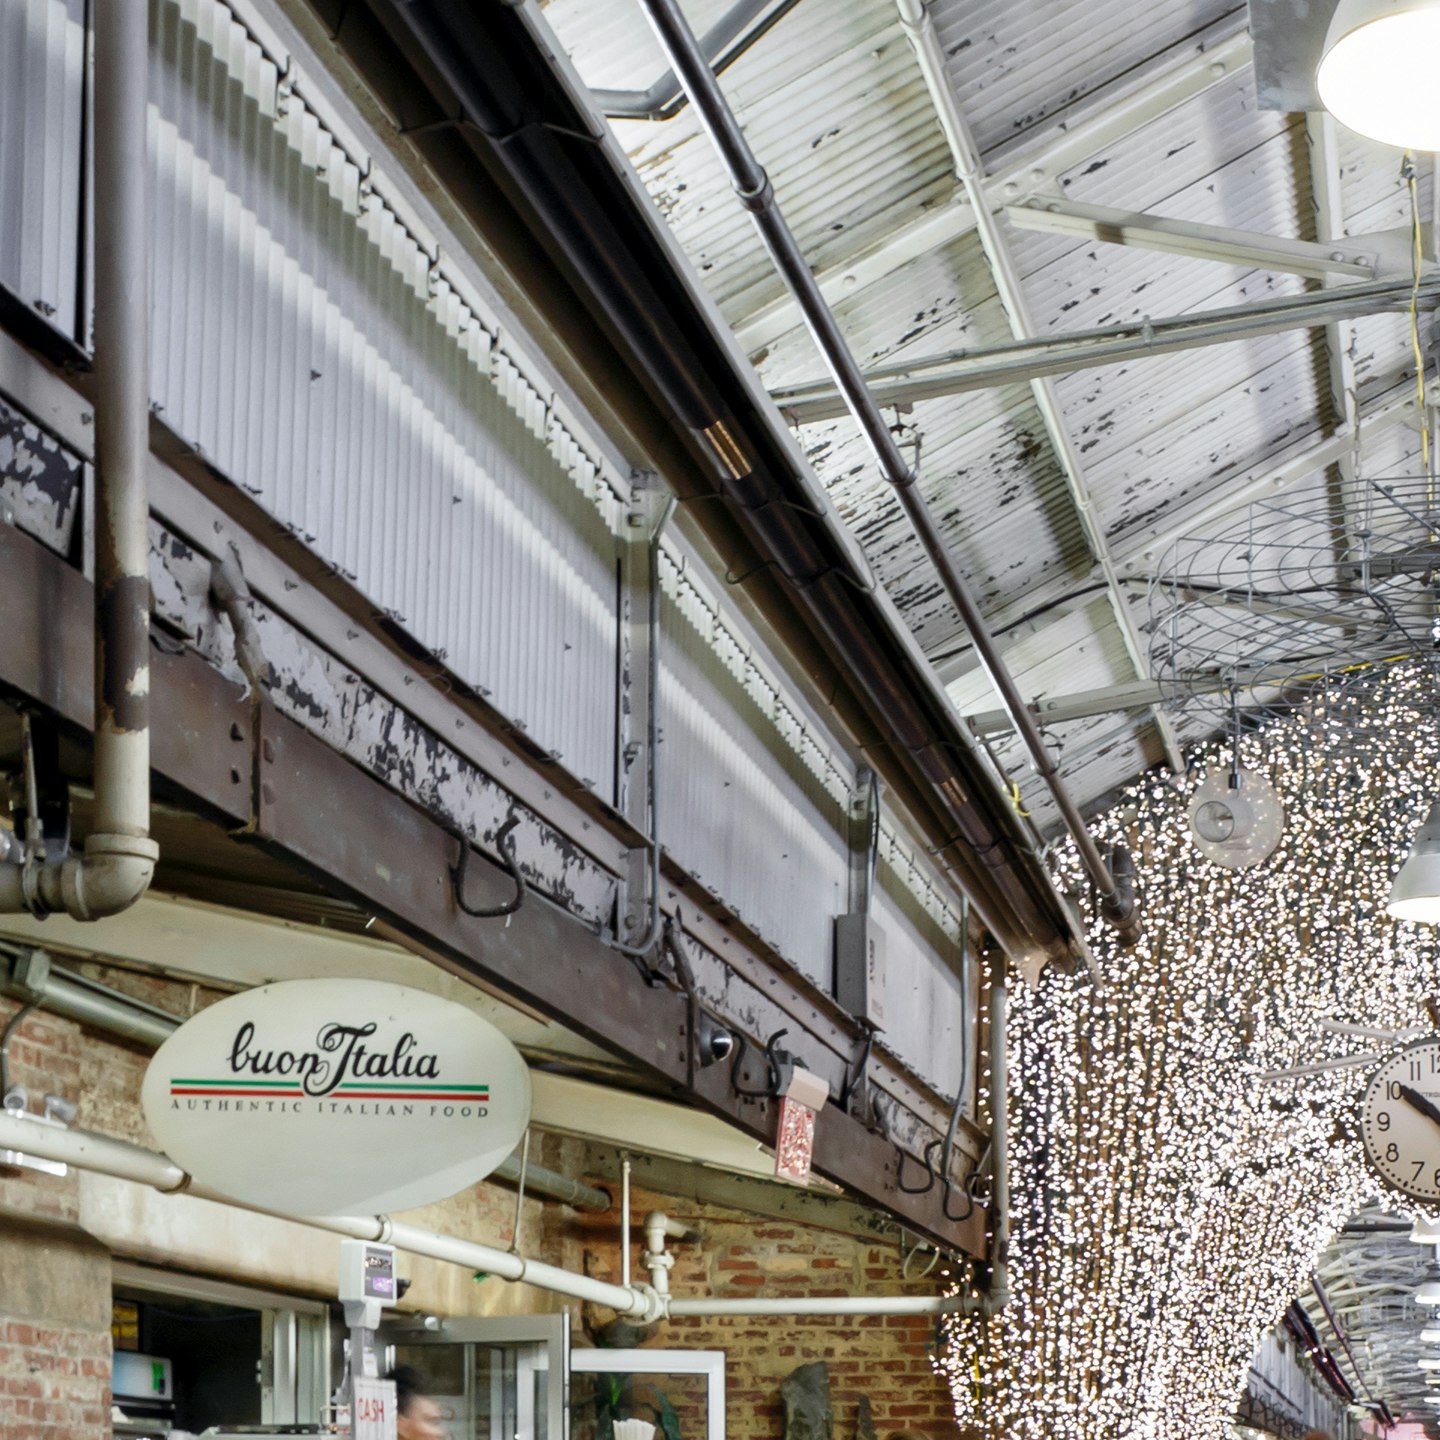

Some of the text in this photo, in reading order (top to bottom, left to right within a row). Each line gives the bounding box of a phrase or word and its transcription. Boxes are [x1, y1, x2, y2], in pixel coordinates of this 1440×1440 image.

[1410, 1061, 1420, 1081] 11
[1386, 1081, 1401, 1100] 10
[170, 1098, 489, 1119] AUTHENTIC ITALIAN FOOD
[1377, 1112, 1390, 1131] 9
[1386, 1143, 1399, 1162] 8
[1411, 1162, 1425, 1181] 7
[357, 1398, 384, 1422] CASH
